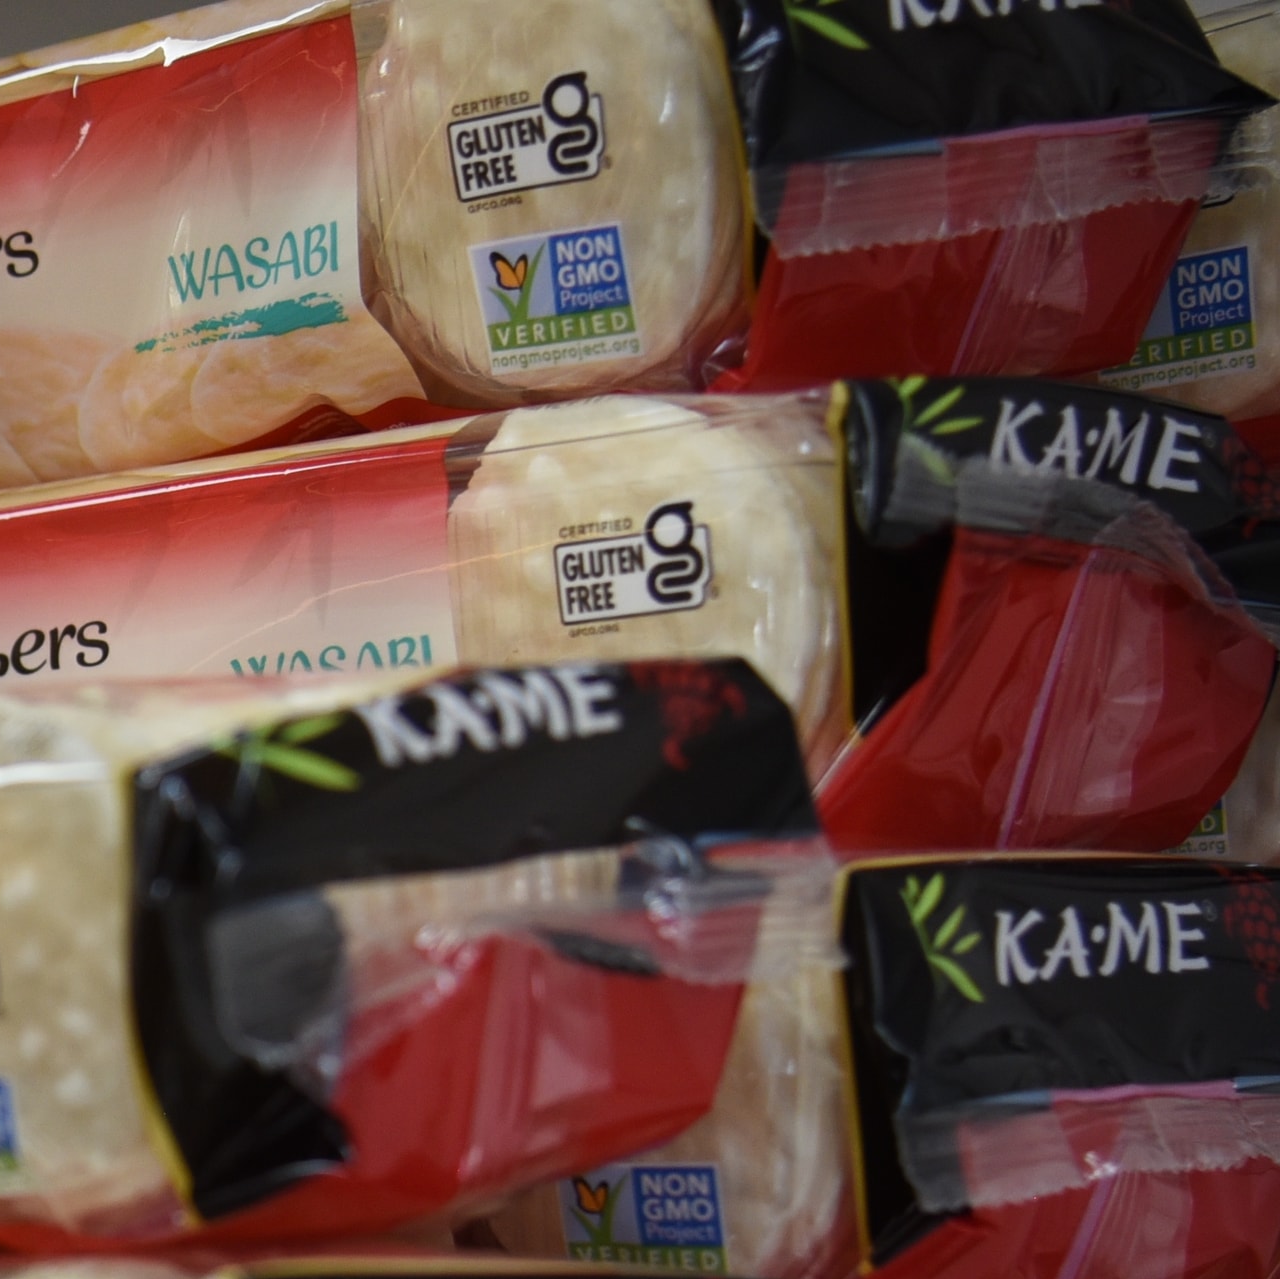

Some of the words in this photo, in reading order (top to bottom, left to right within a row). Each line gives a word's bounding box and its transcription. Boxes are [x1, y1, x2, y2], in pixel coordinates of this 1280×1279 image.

[451, 90, 530, 117] CERTIFIED
[456, 114, 546, 159] GLUTEN
[460, 154, 518, 192] FREE
[166, 219, 339, 303] WASABI
[555, 233, 614, 264] NON
[558, 258, 621, 288] GMO
[1176, 254, 1241, 287] NON
[559, 285, 624, 310] Project
[1177, 278, 1244, 309] GMO
[495, 311, 628, 348] VERIFIED
[1178, 303, 1245, 329] Project
[492, 337, 640, 369] nongmoproject.org
[562, 544, 646, 582] GLUTEN
[564, 581, 616, 615] FREE
[641, 1172, 710, 1197] NON
[642, 1197, 715, 1222] GMO
